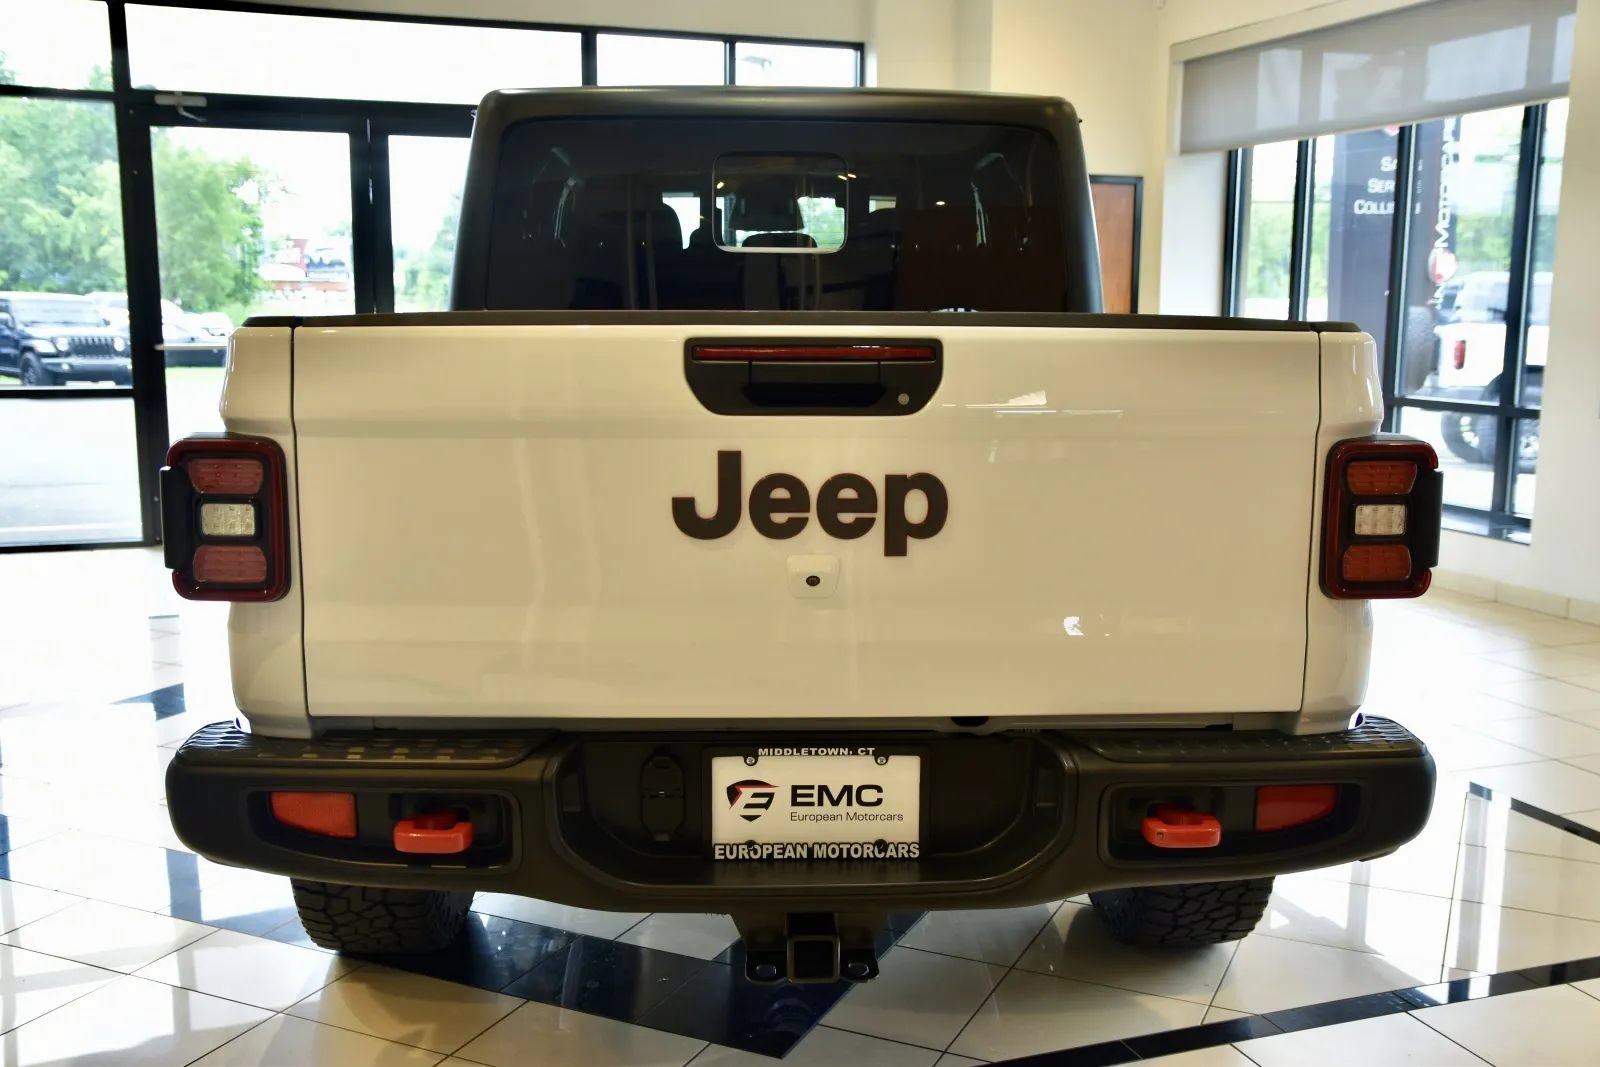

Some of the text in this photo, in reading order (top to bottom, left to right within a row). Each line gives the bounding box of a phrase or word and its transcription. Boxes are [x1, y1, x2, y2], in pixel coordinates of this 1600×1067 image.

[671, 450, 949, 557] Jeep
[857, 747, 876, 756] CT
[791, 784, 884, 807] EMC
[790, 811, 904, 824] European Motorcars
[714, 843, 920, 860] EUROPEAN MOTORCARS
